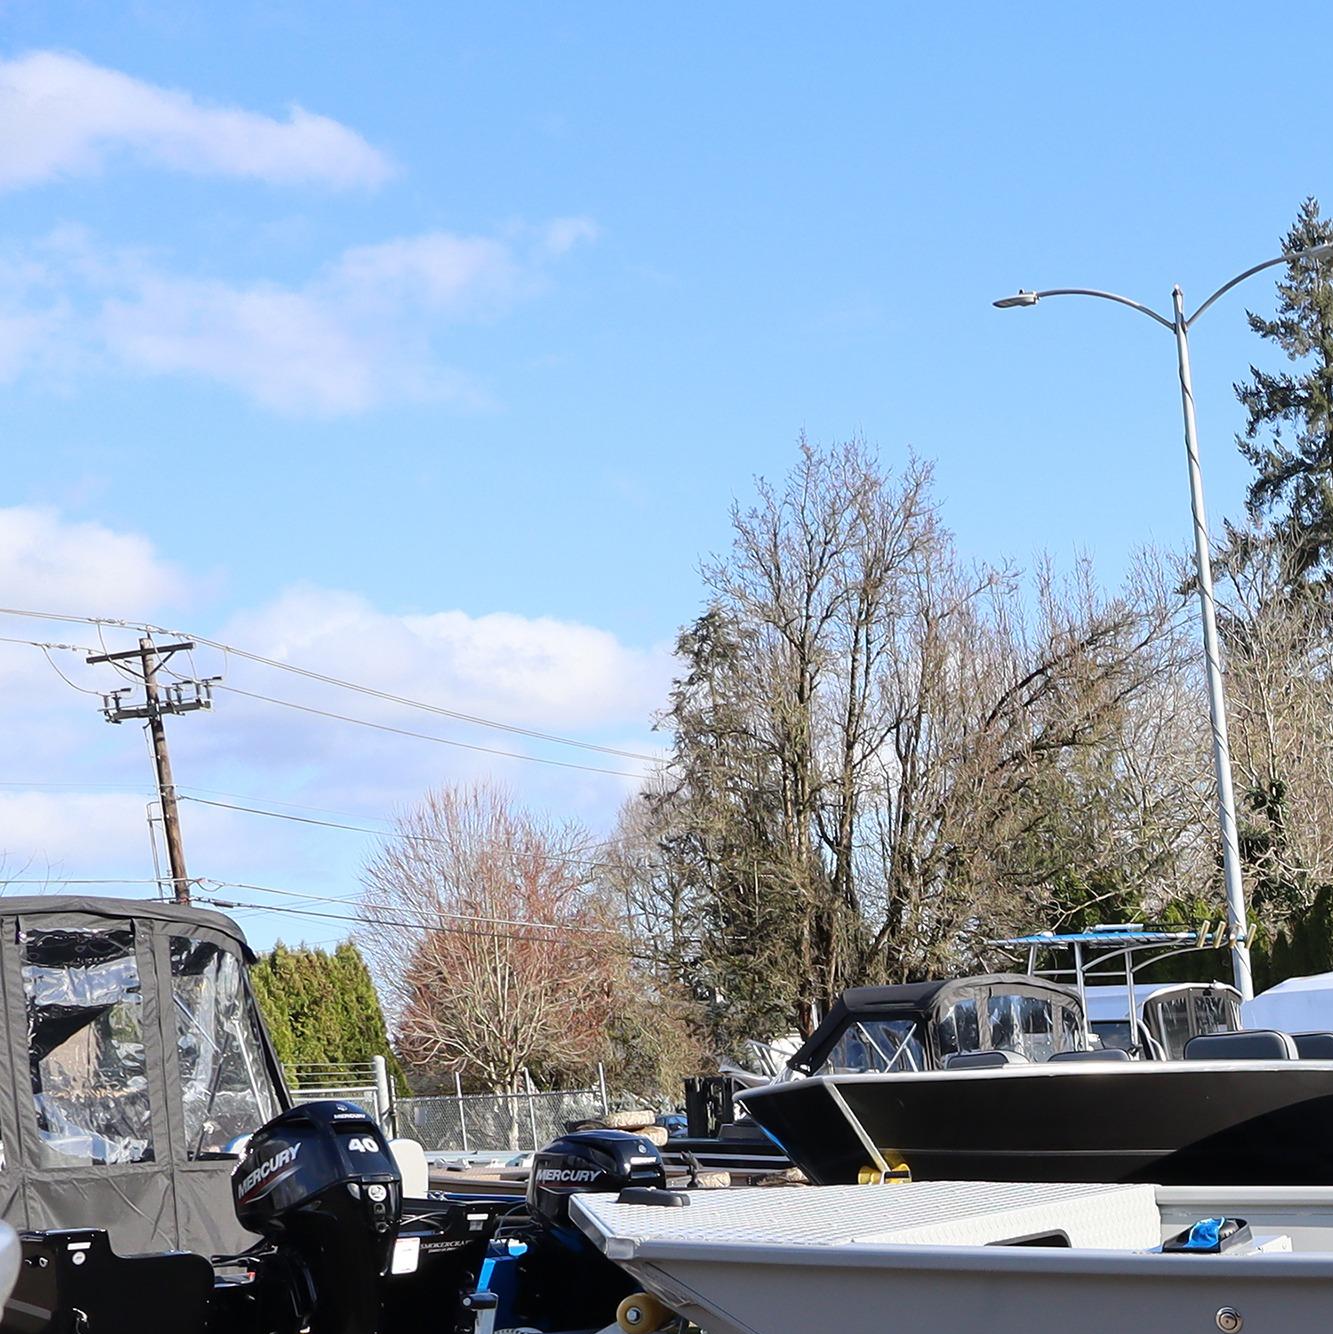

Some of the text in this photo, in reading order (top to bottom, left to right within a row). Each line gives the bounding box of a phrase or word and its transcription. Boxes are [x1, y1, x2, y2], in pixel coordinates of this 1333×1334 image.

[348, 1137, 379, 1153] 40
[237, 1142, 301, 1197] MERCURY
[536, 1168, 601, 1182] MERCURY
